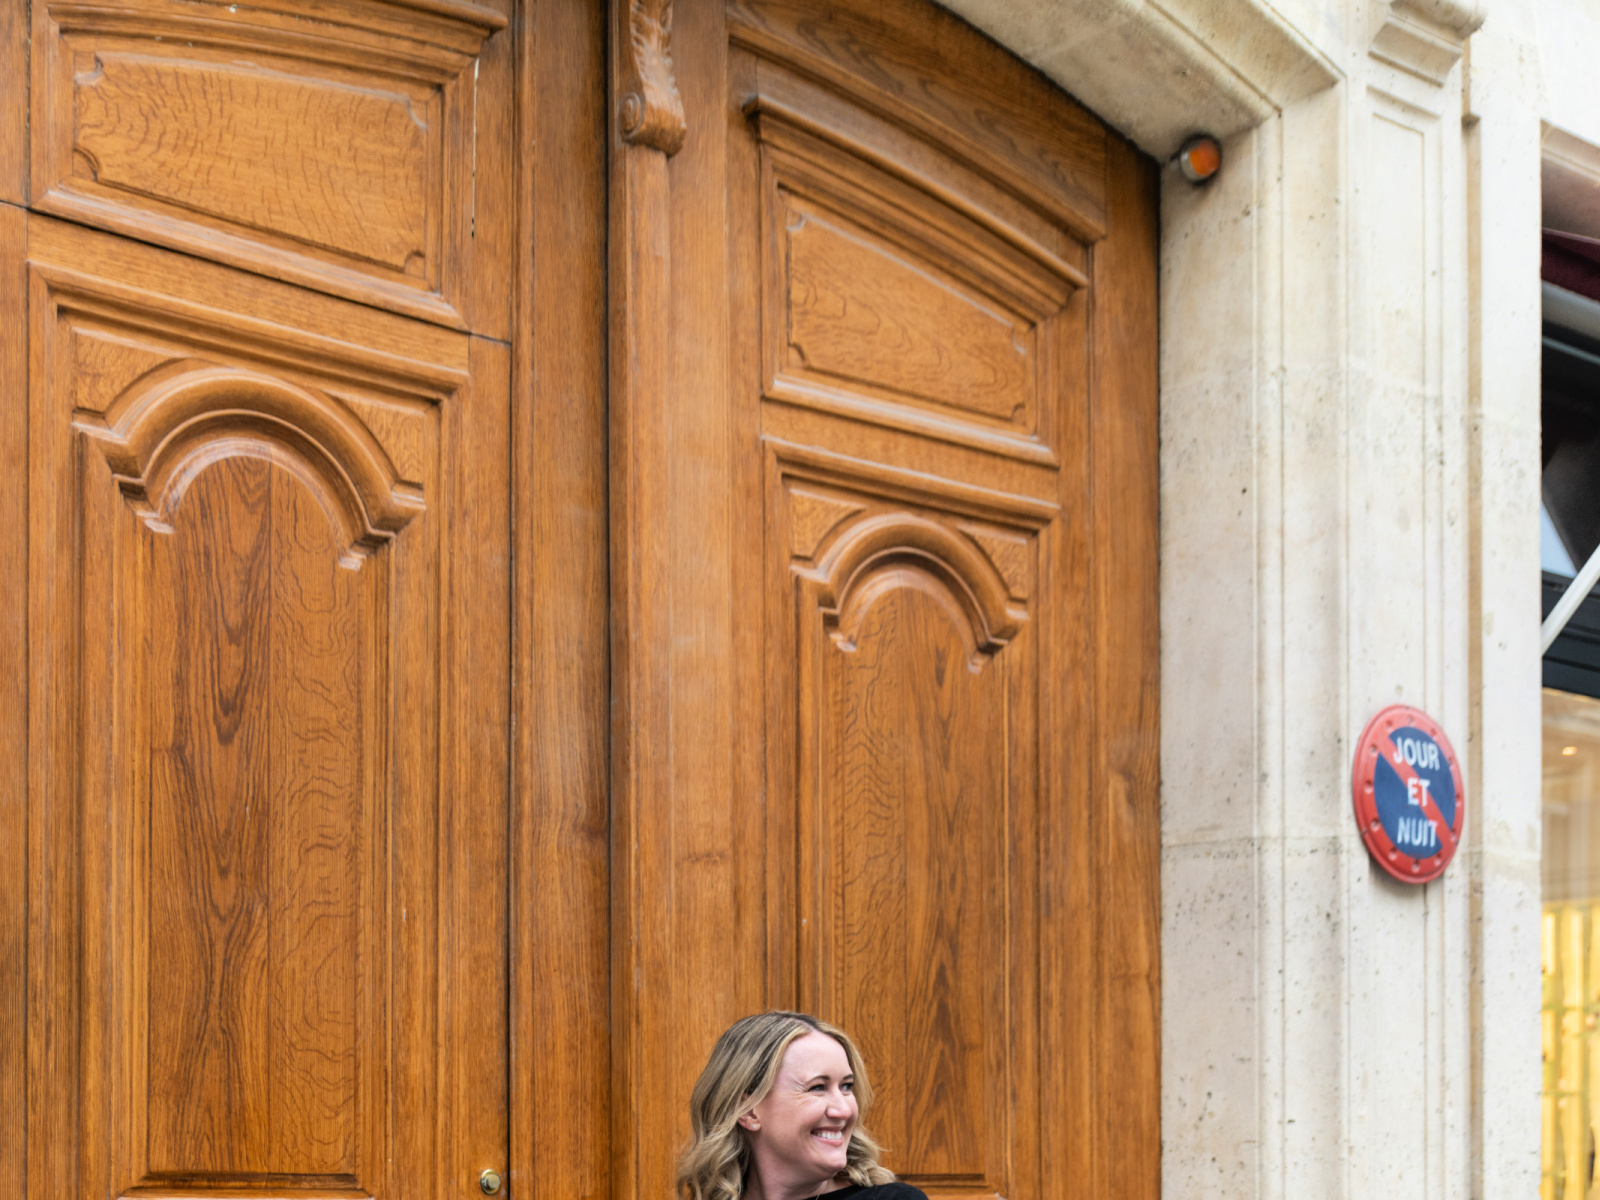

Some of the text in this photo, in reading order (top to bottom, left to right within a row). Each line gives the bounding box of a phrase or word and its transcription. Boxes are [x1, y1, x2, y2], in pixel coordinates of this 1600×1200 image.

[1393, 737, 1440, 771] JOUR
[1407, 777, 1430, 807] ET
[1397, 816, 1438, 847] NUIT
